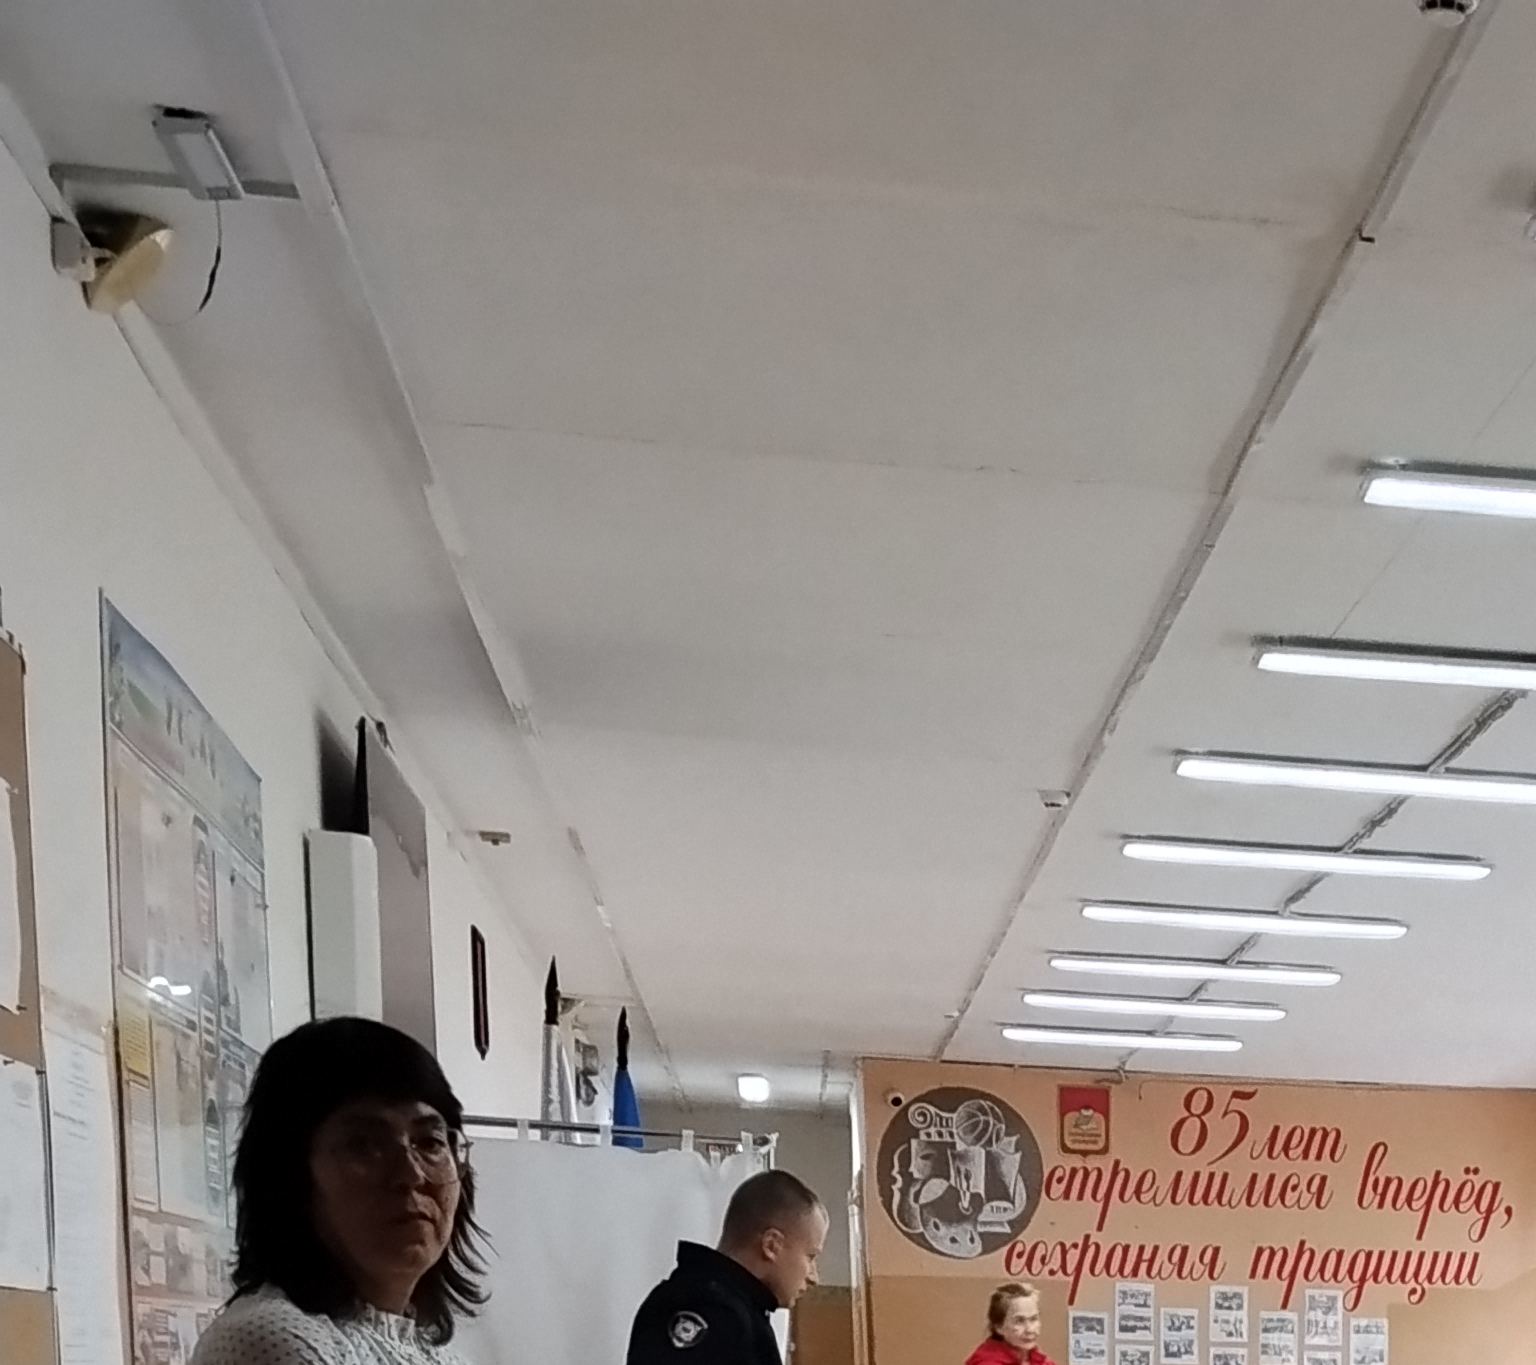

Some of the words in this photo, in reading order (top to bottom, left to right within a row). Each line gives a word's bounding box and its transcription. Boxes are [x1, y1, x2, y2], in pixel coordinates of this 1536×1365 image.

[1170, 1087, 1259, 1166] 85
[1250, 1124, 1348, 1163] лет
[1044, 1158, 1334, 1233] стремимся
[1357, 1141, 1513, 1243] вперёд,
[1003, 1233, 1227, 1307] сохраняя
[1249, 1239, 1483, 1312] традиции
